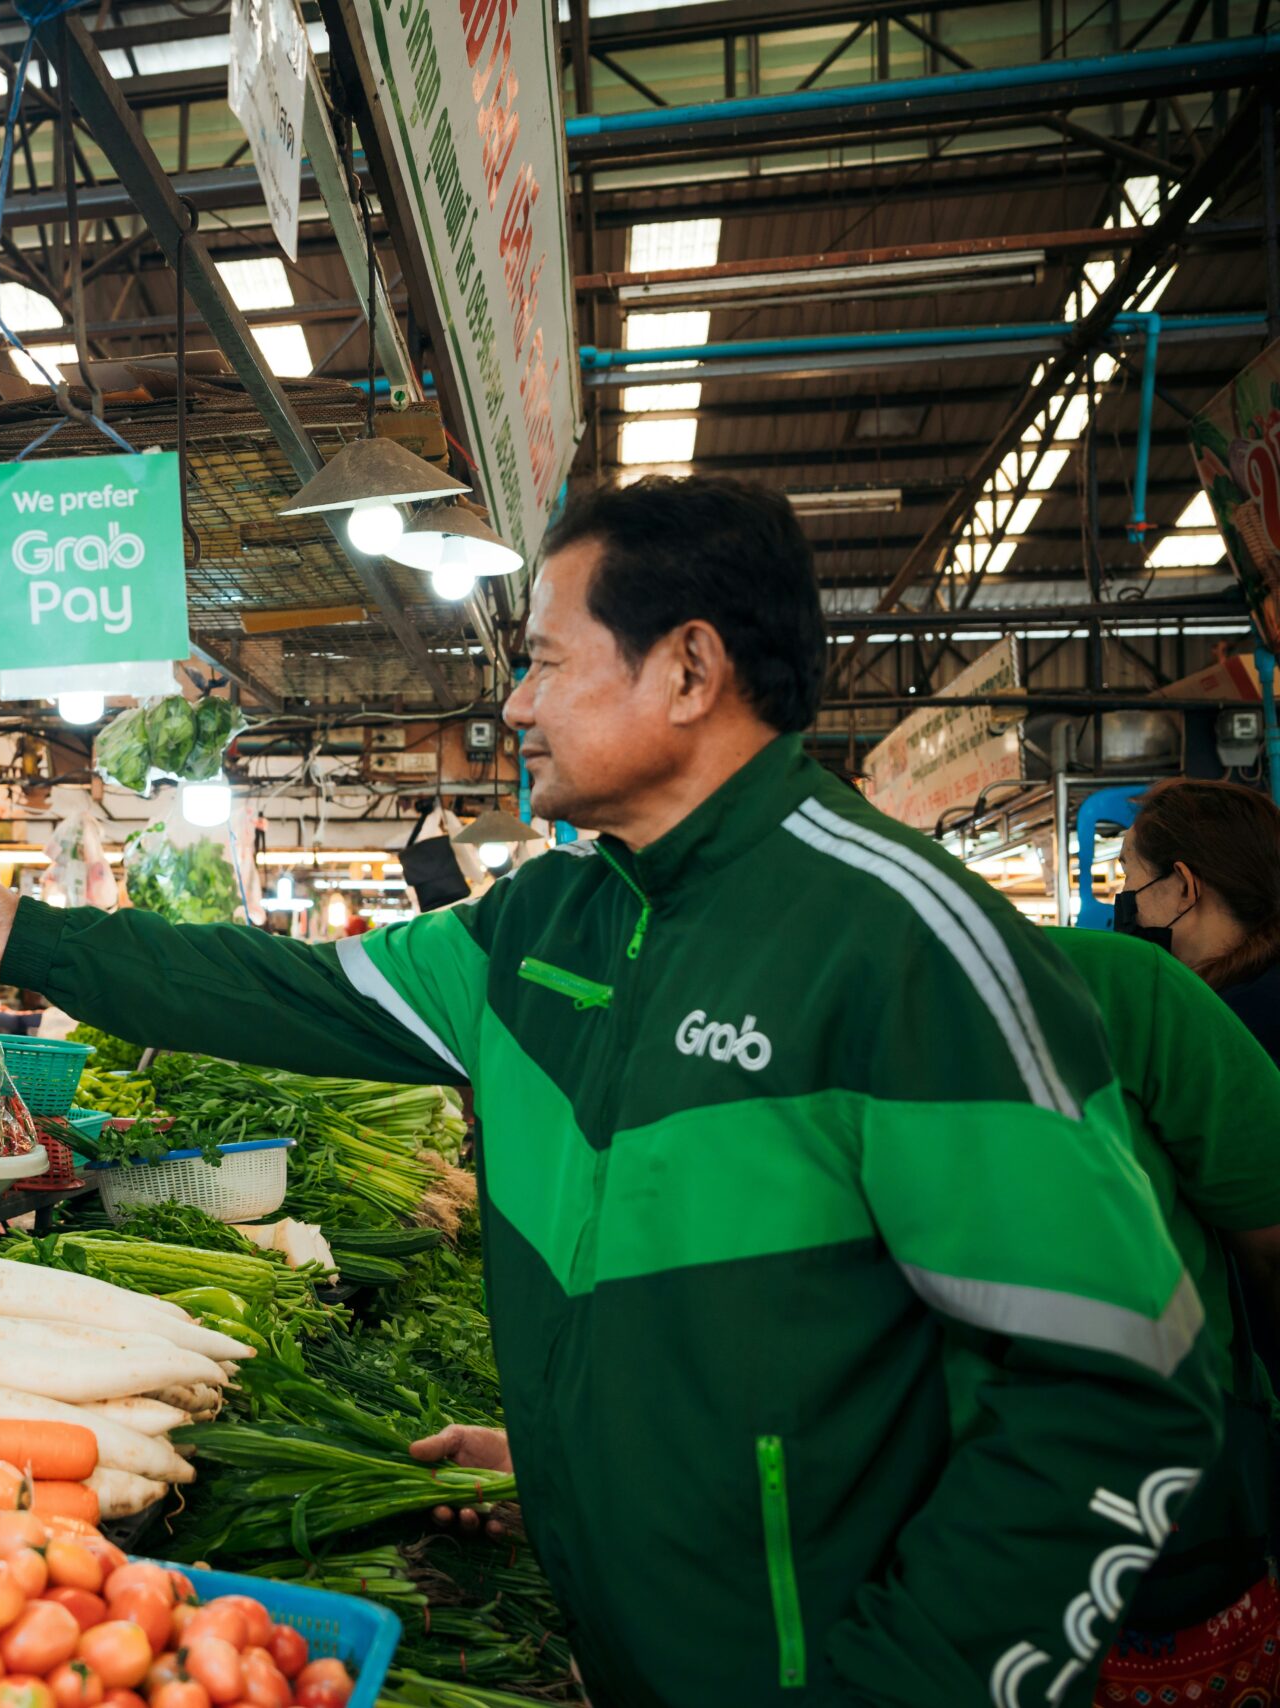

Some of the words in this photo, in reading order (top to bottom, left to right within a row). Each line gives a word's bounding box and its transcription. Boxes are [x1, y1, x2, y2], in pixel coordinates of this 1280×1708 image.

[424, 106, 471, 253] คุณภาพดี
[455, 207, 478, 296] โทร
[12, 489, 55, 514] We
[60, 484, 140, 516] prefer
[11, 521, 145, 575] Grab
[28, 580, 134, 634] Pay
[675, 1009, 772, 1071] Grab
